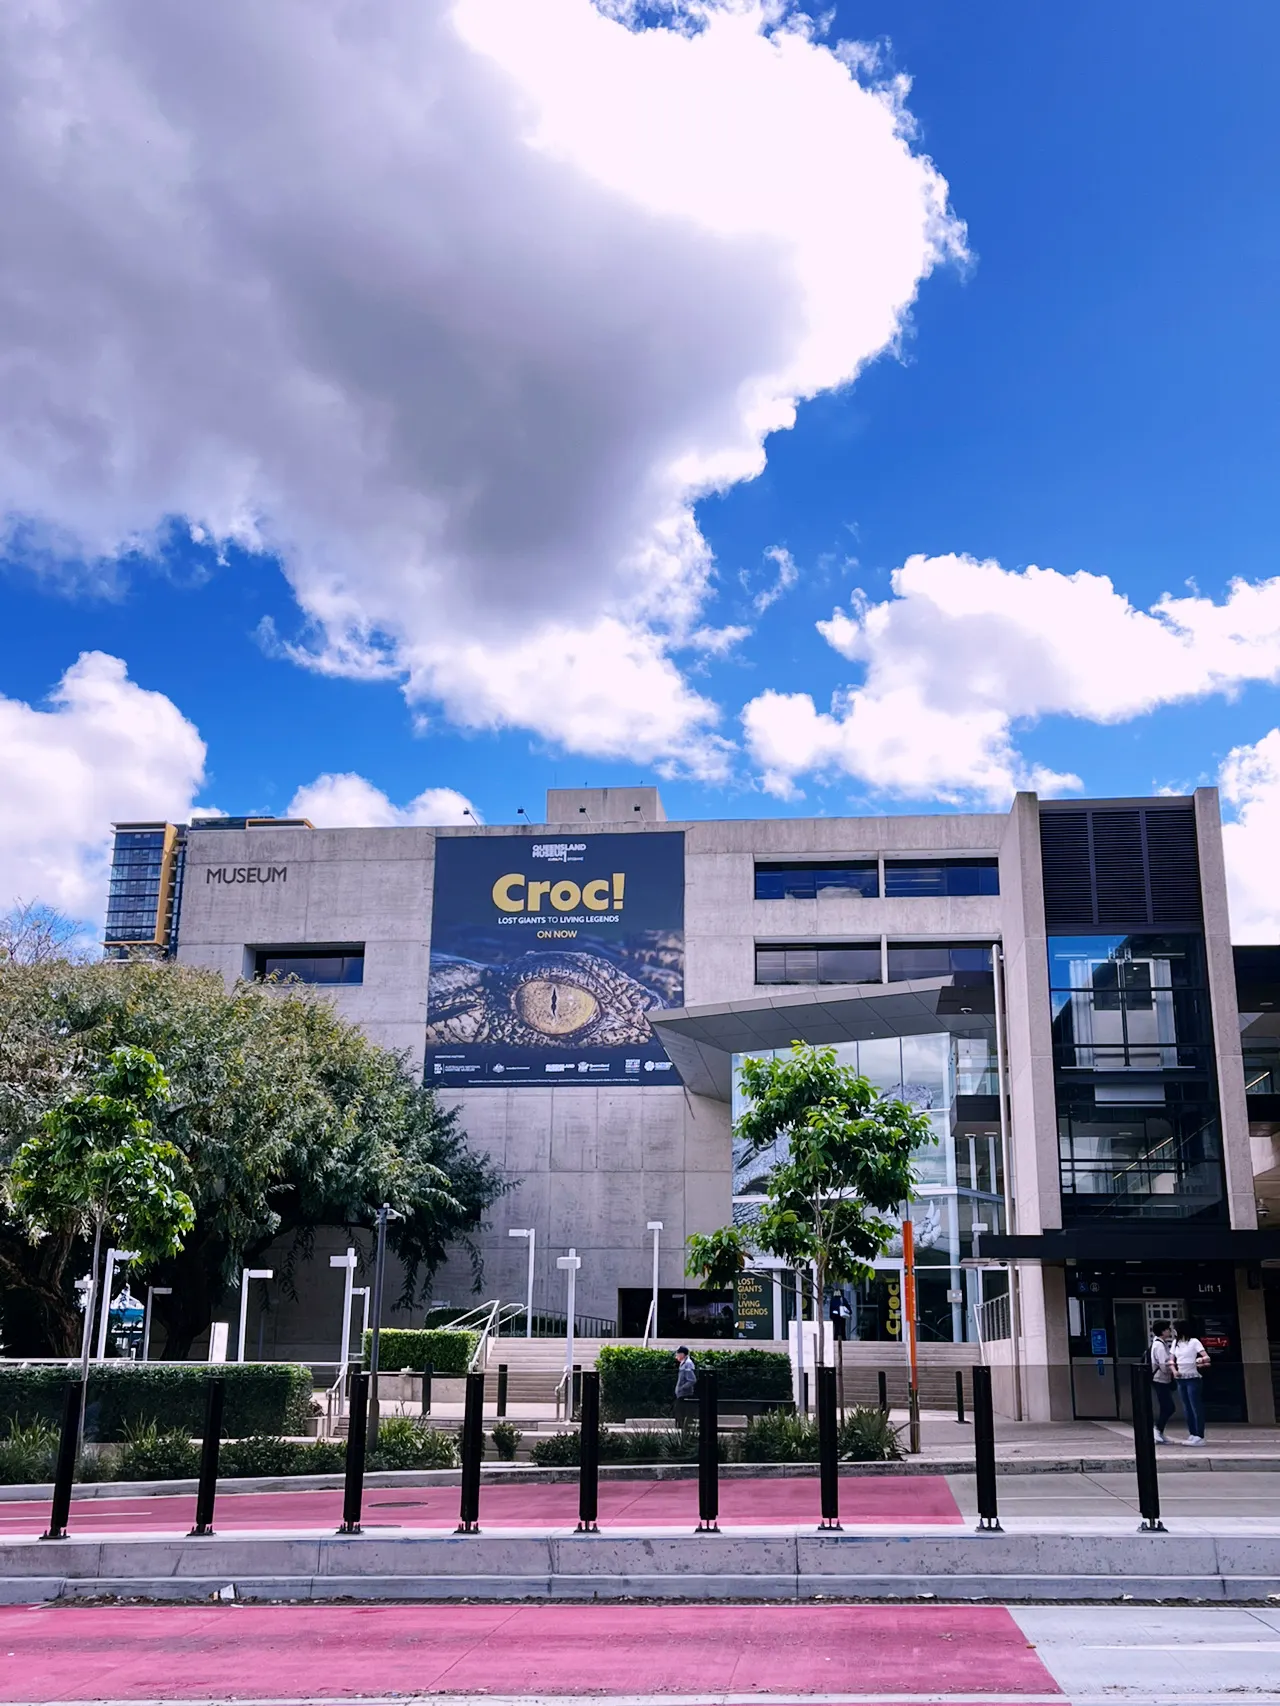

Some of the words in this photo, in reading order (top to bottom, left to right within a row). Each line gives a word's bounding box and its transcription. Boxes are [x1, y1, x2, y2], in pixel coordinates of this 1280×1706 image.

[206, 866, 287, 884] MUSEUM
[492, 872, 626, 912] Croc!
[498, 916, 518, 925] LOST
[518, 916, 546, 924] GIANTS
[547, 916, 559, 924] TO
[560, 915, 584, 924] LIVING
[586, 915, 619, 923] LEGENDS
[537, 930, 551, 938] ON
[553, 930, 577, 938] NOW
[737, 1285, 762, 1293] GIANTS
[1198, 1284, 1214, 1292] Lift
[1217, 1284, 1222, 1292] 1
[737, 1300, 760, 1308] LIVING
[737, 1307, 768, 1316] LEGENDS
